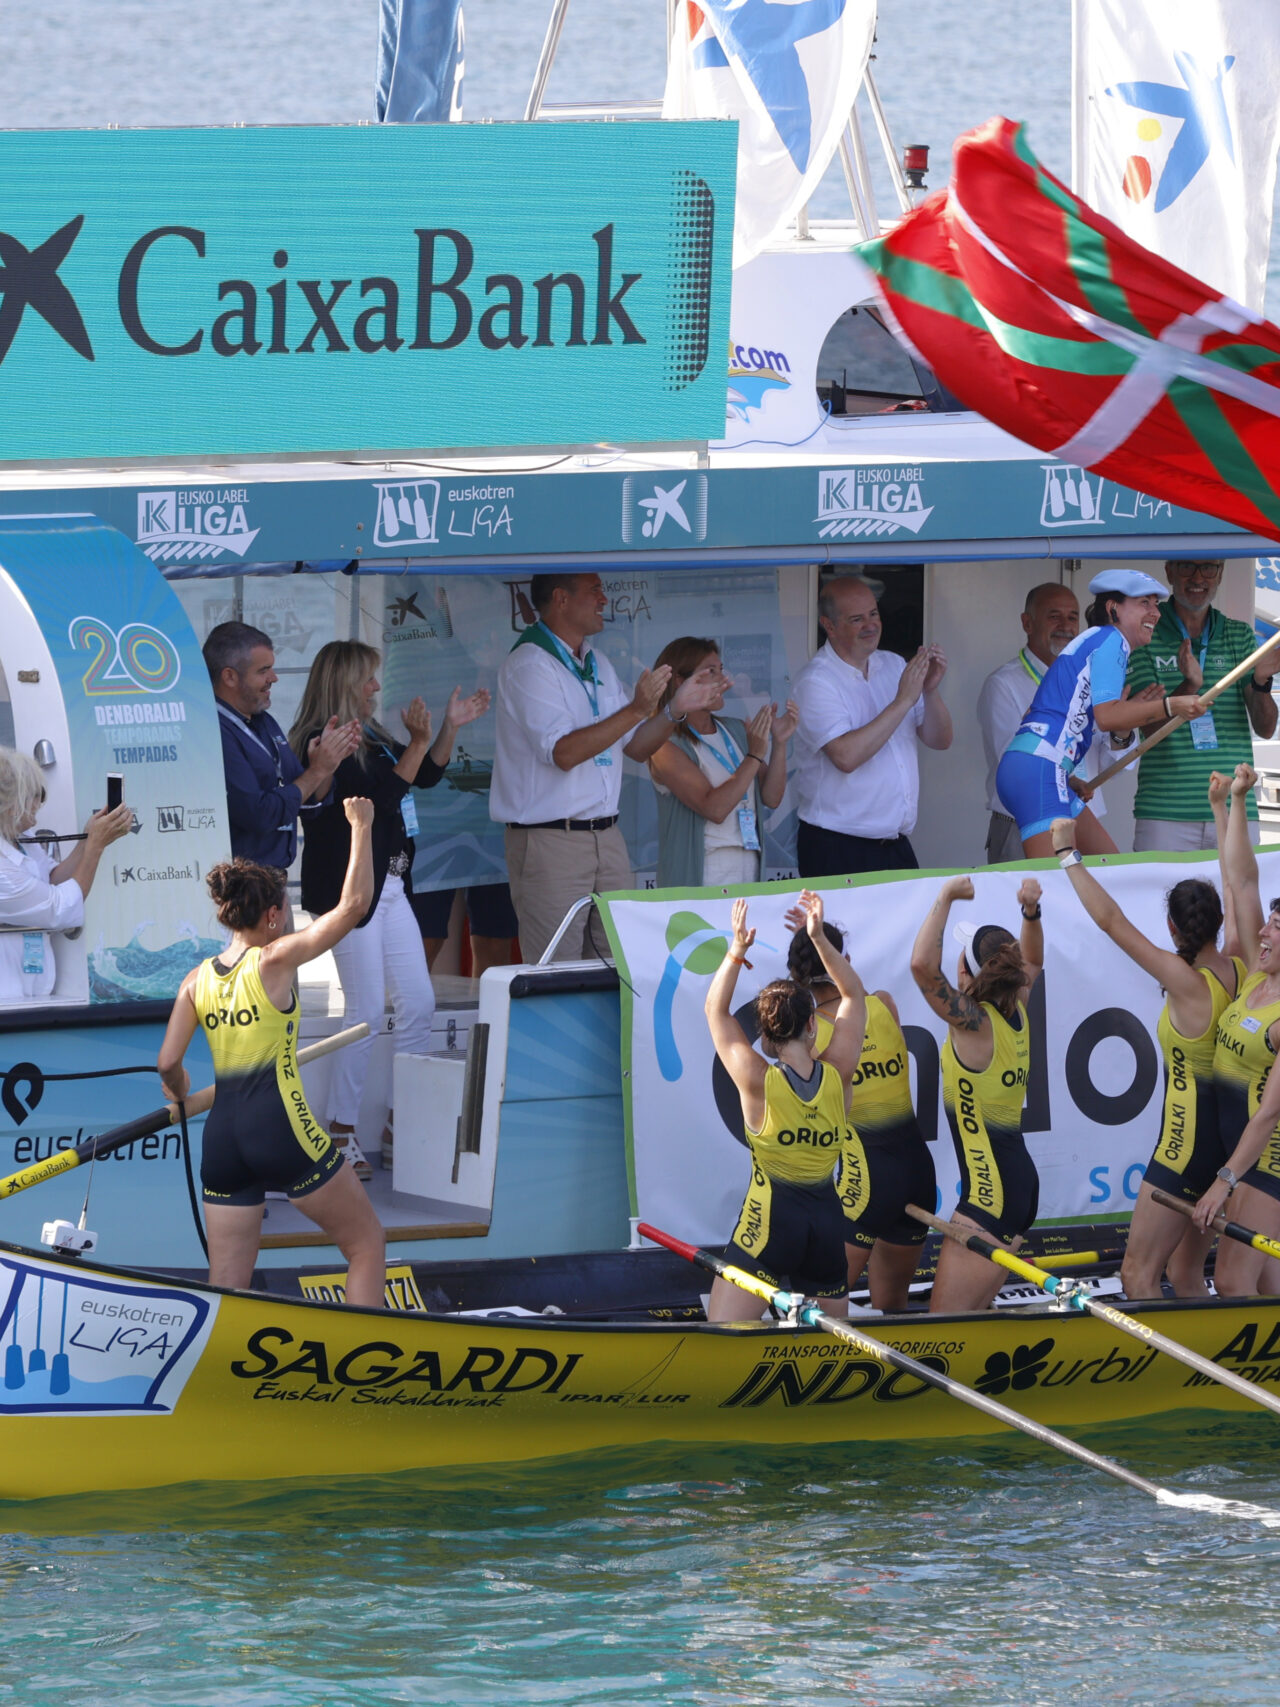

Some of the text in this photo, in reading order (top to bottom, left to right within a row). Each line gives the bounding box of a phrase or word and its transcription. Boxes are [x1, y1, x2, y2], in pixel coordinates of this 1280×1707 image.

[117, 223, 647, 357] CaixaBank
[856, 468, 925, 483] EUSKO LABEL
[178, 489, 249, 504] EUSKO LABEL
[447, 485, 515, 501] euskotren
[856, 483, 924, 512] LIGA
[178, 504, 249, 535] LIGA
[447, 504, 514, 538] LIGA
[598, 580, 649, 594] skotren
[382, 628, 438, 645] CaixaBank
[68, 616, 181, 696] 20
[94, 702, 187, 726] DENBORALDI
[103, 725, 182, 745] TEMPORADAS
[113, 745, 178, 764] TEMPADAS
[137, 866, 193, 882] CaixaBank
[205, 1004, 260, 1030] ORIO!
[1216, 1025, 1245, 1056] RIALKI
[852, 1053, 904, 1086] ORIO!
[1172, 1047, 1187, 1092] ORIO
[958, 1077, 980, 1135] ORIO
[290, 1090, 327, 1153] ORIALKI
[1164, 1103, 1186, 1161] ORIALKI
[777, 1126, 839, 1147] ORIO!
[20, 1157, 72, 1187] CaixaBank
[841, 1153, 861, 1209] ORIALKI
[80, 1300, 184, 1327] euskotren
[69, 1322, 173, 1360] LIGA
[762, 1345, 864, 1360] TRANSPORTES
[230, 1326, 584, 1394] SAGARDI
[1040, 1346, 1159, 1388] urbil
[252, 1382, 507, 1409] Euskal Sukaldariak
[718, 1354, 950, 1409] INDO
[559, 1393, 692, 1404] IPAR LUR
